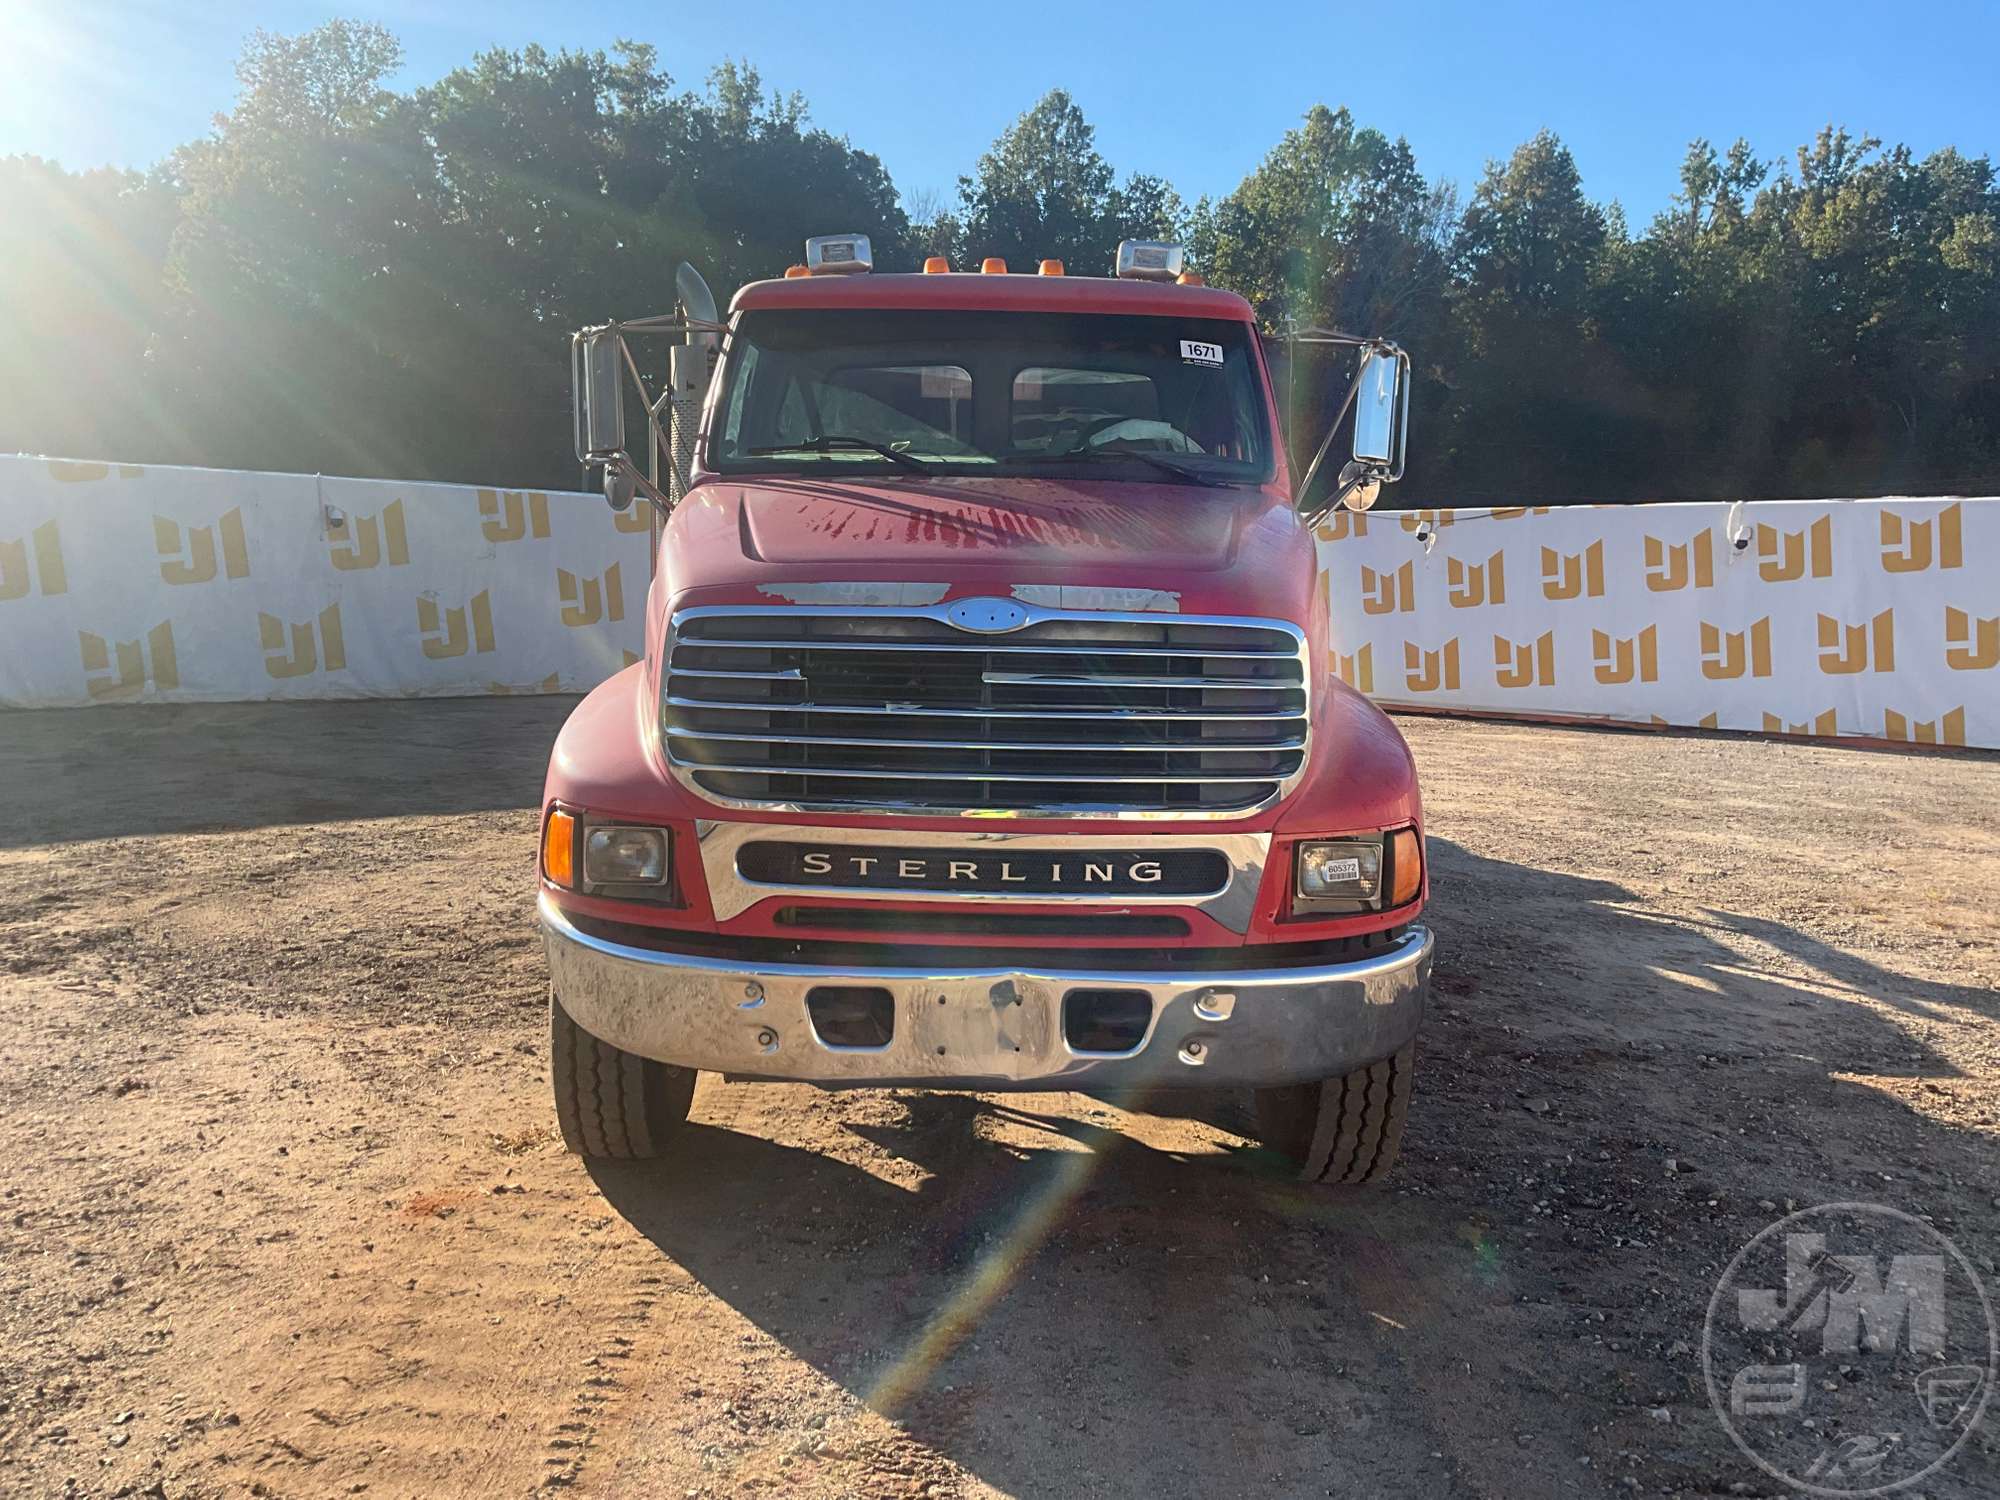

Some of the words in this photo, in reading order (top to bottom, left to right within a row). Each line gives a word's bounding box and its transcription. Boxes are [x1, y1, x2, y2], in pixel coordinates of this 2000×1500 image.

[1187, 344, 1215, 358] 1671
[802, 852, 1164, 882] STERLING
[1328, 863, 1357, 874] 605372
